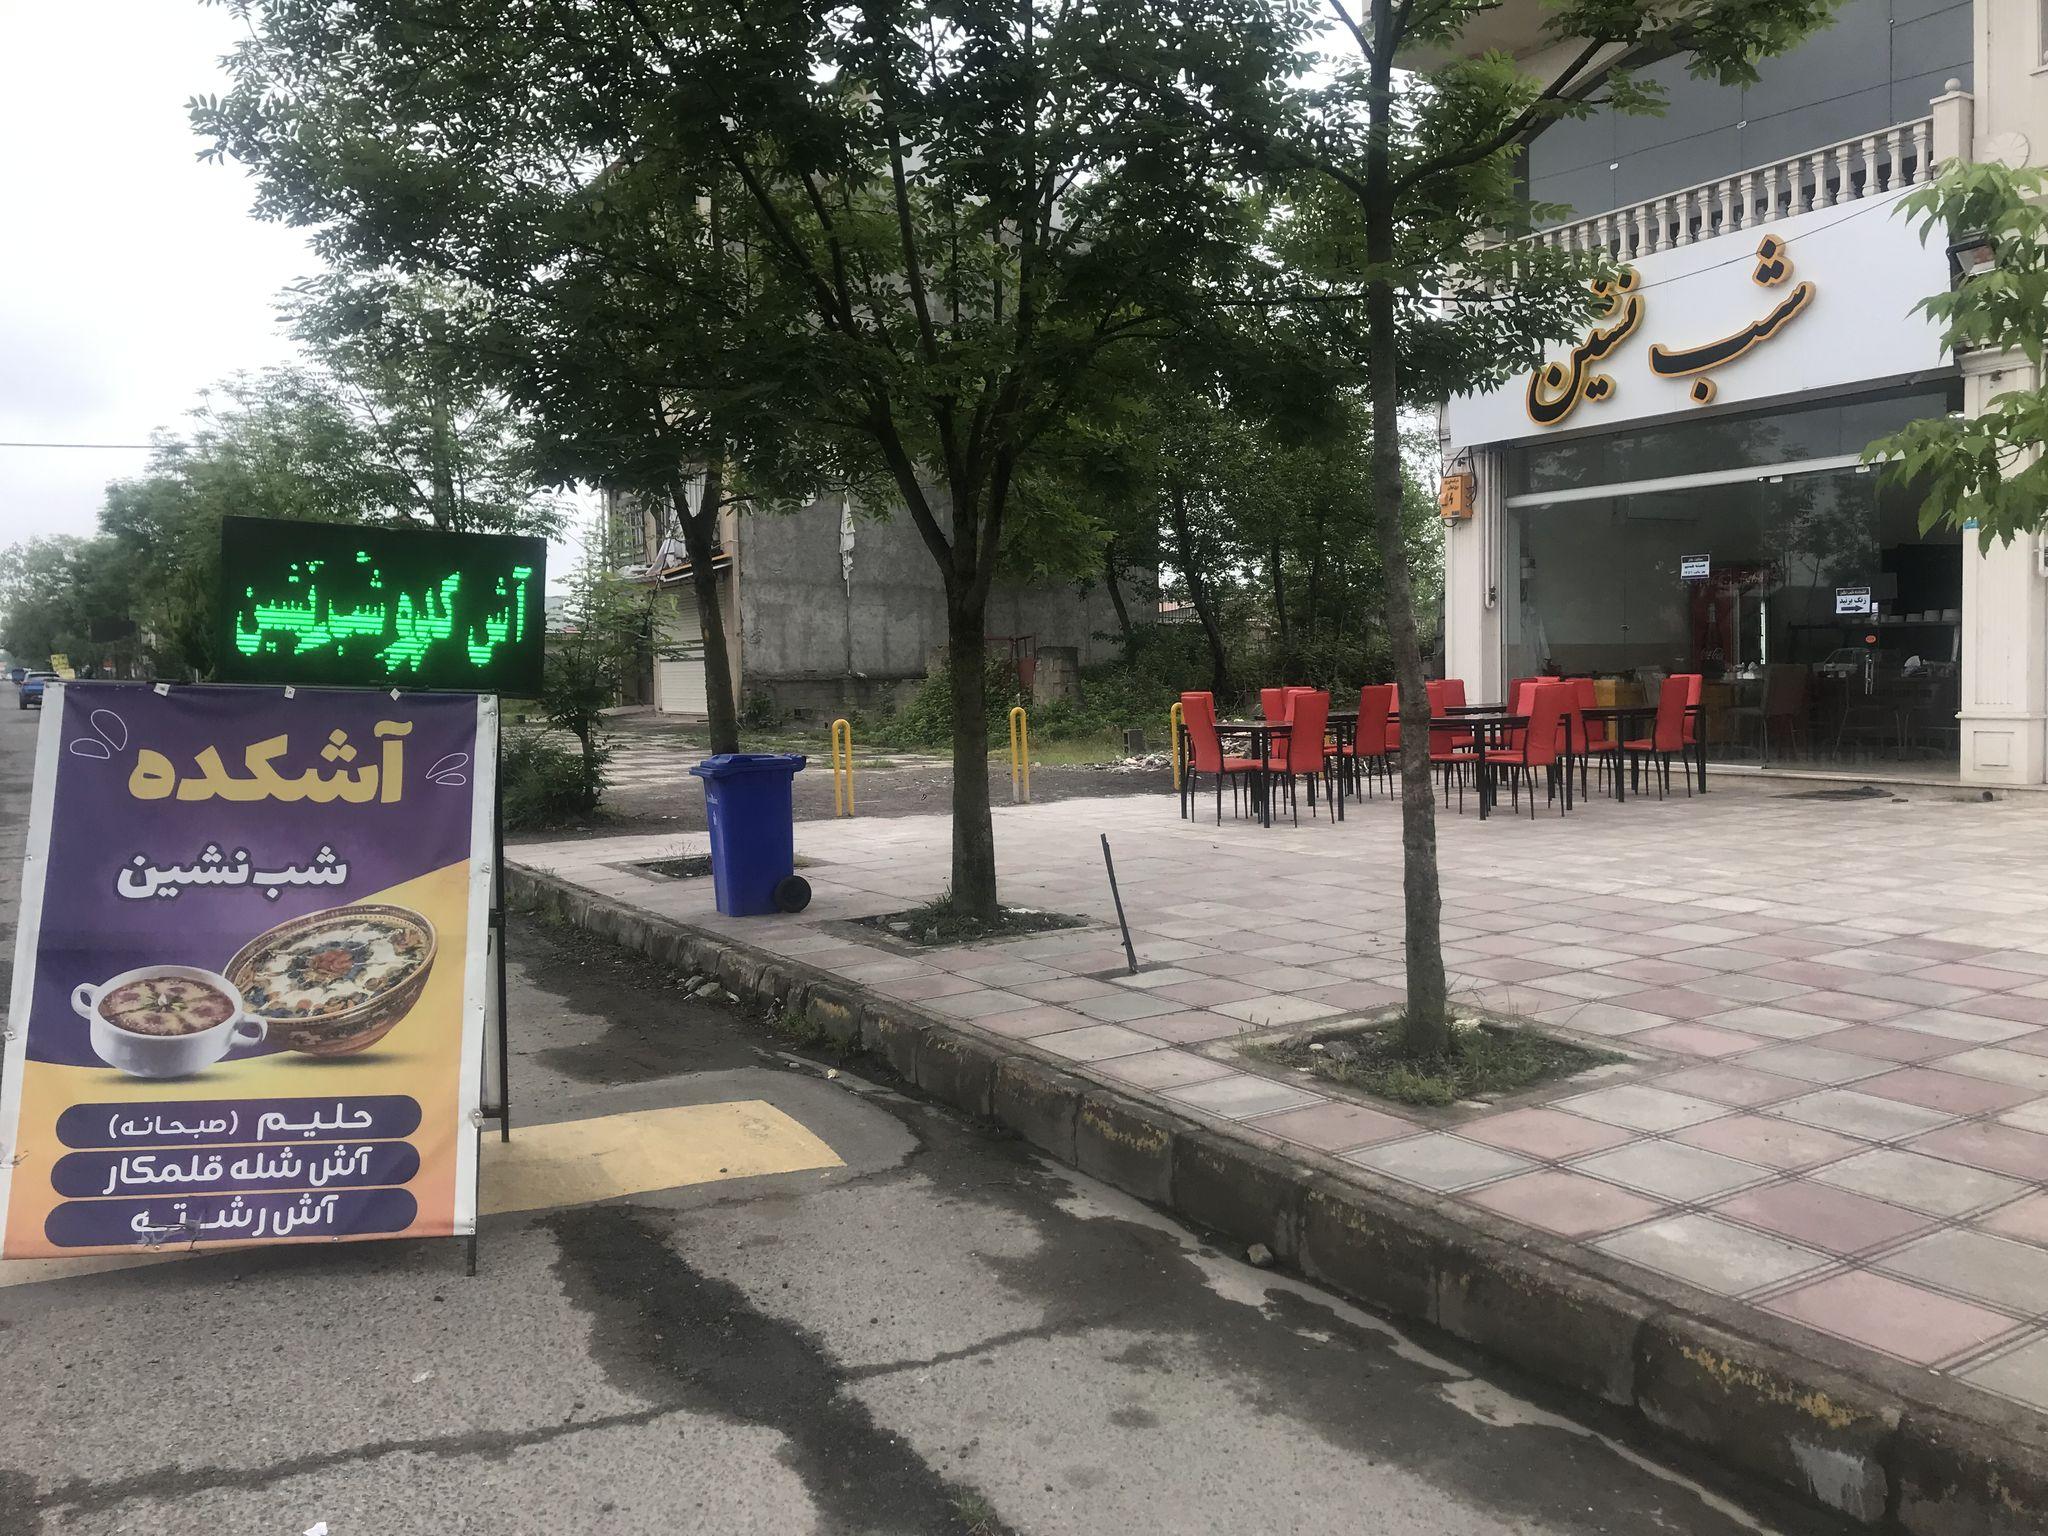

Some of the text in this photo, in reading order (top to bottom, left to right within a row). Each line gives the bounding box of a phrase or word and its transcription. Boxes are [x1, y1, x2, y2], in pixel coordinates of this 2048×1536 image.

[1525, 233, 1817, 427] شب نشین
[128, 720, 413, 803] آشکده
[108, 1102, 373, 1141] حلیم (صبحانه)
[102, 1144, 373, 1195] آش شله قلمکار
[130, 1192, 339, 1237] آش رشته
